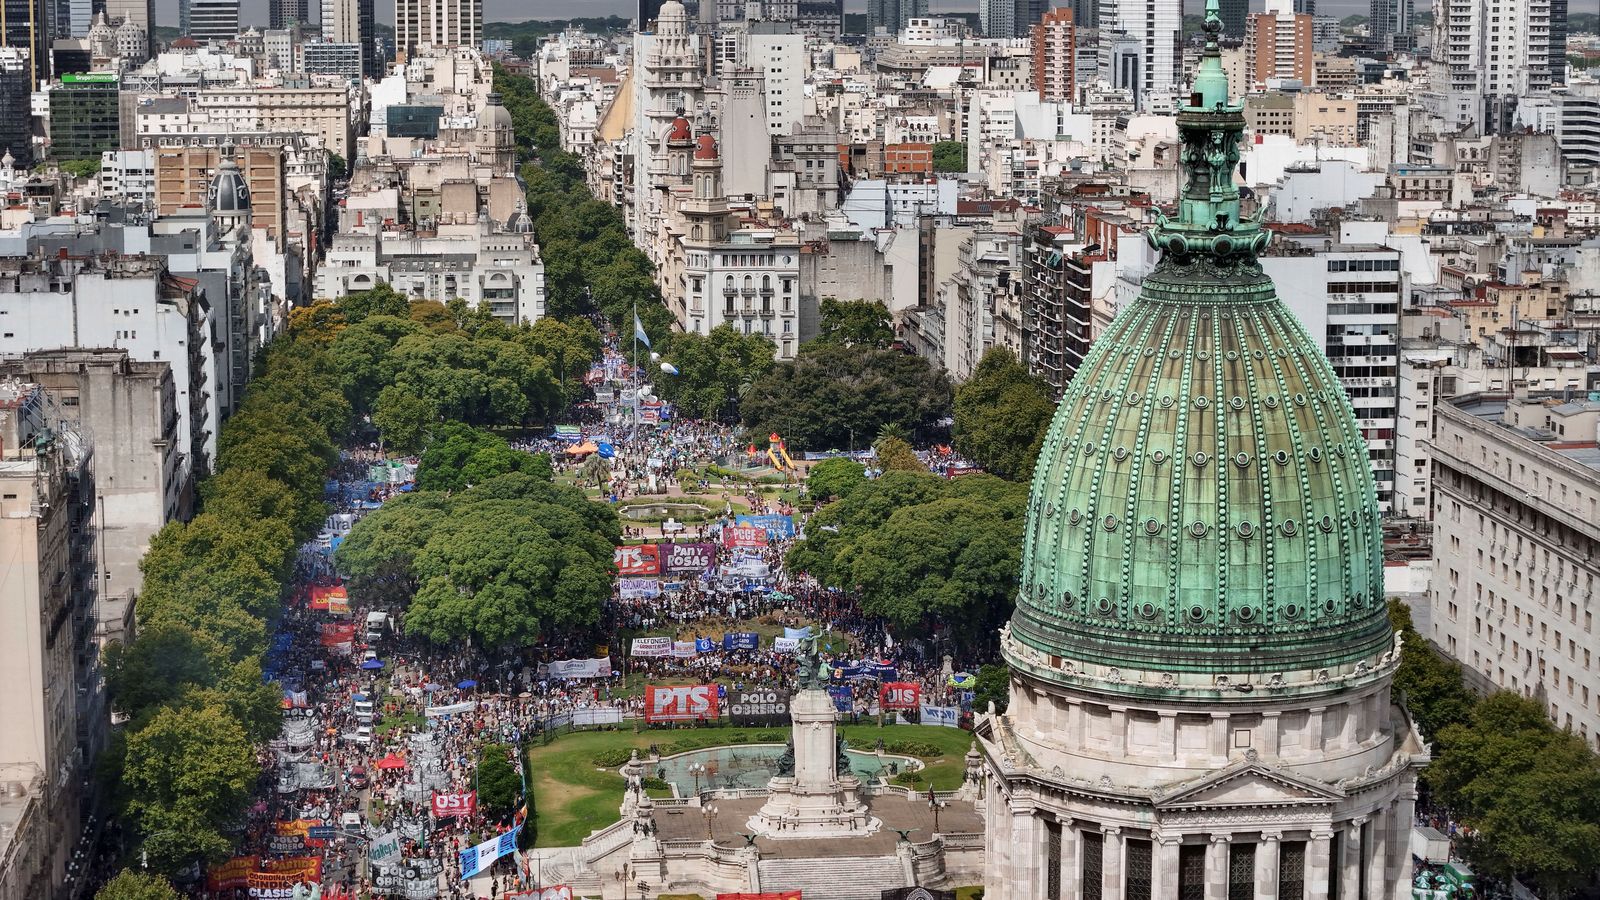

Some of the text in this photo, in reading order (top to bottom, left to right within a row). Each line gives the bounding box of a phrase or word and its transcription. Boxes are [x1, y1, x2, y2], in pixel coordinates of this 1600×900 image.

[667, 555, 709, 567] ROSAS
[653, 686, 710, 715] PTS
[741, 692, 777, 704] POLO
[731, 703, 786, 715] OBRERO
[436, 793, 471, 808] OST
[269, 842, 304, 850] OBRERO
[272, 858, 317, 870] PARTIDO
[380, 866, 416, 879] POLO
[248, 880, 292, 889] SINDIC
[248, 887, 293, 898] CLASIS
